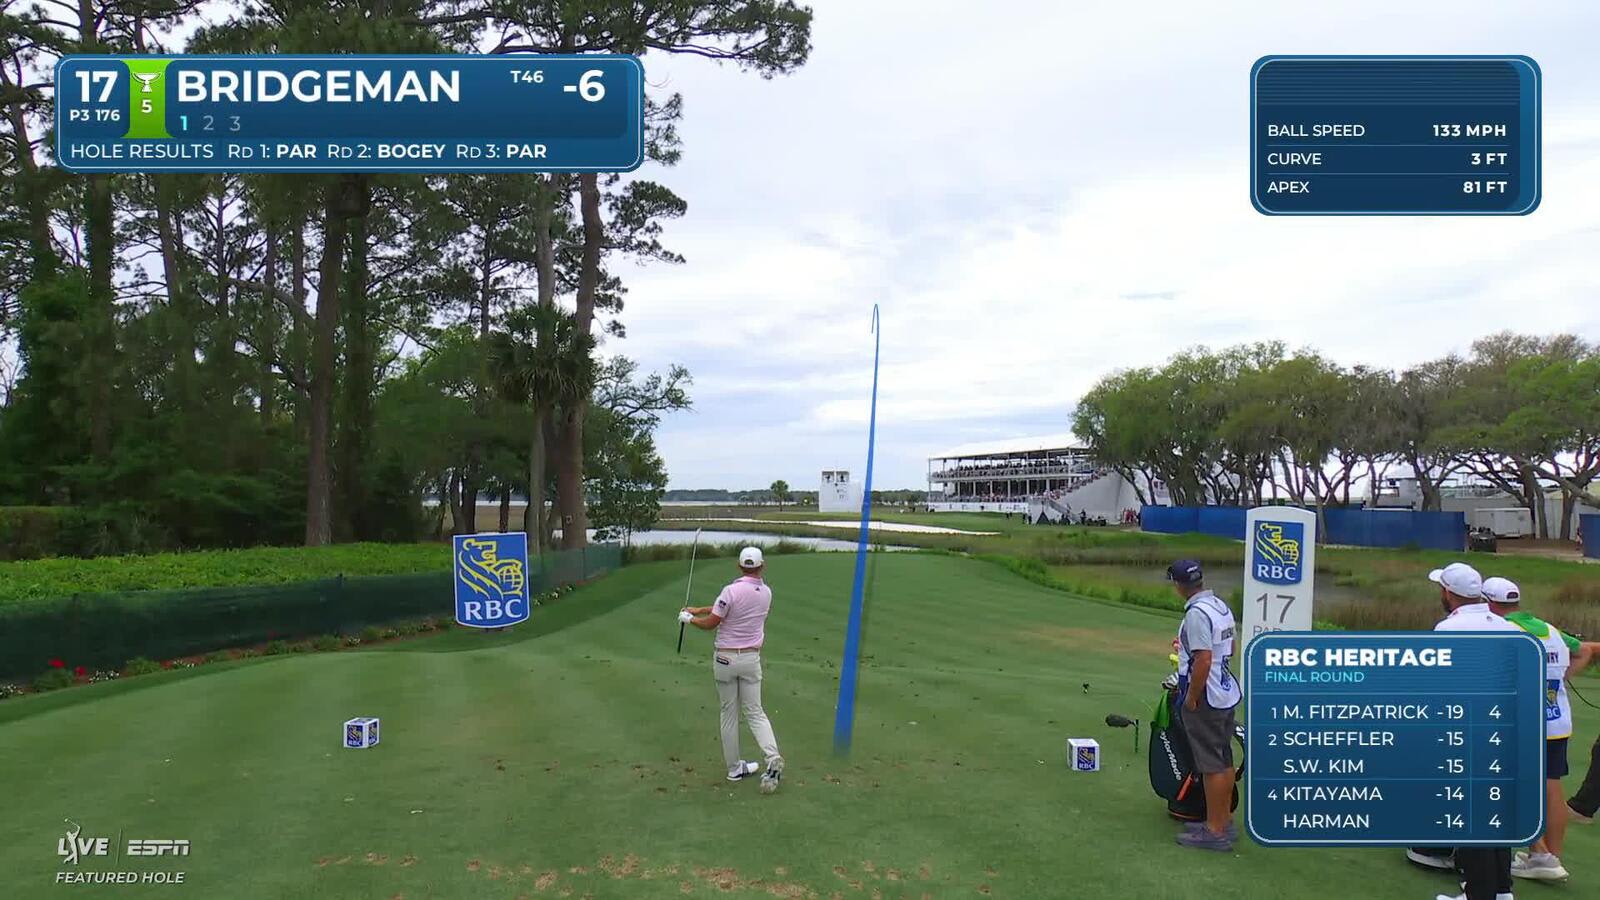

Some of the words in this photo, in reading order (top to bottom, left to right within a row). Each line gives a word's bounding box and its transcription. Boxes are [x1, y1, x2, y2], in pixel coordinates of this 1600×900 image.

[1257, 564, 1296, 580] RBC
[463, 598, 522, 621] RBC
[1256, 592, 1296, 624] 17
